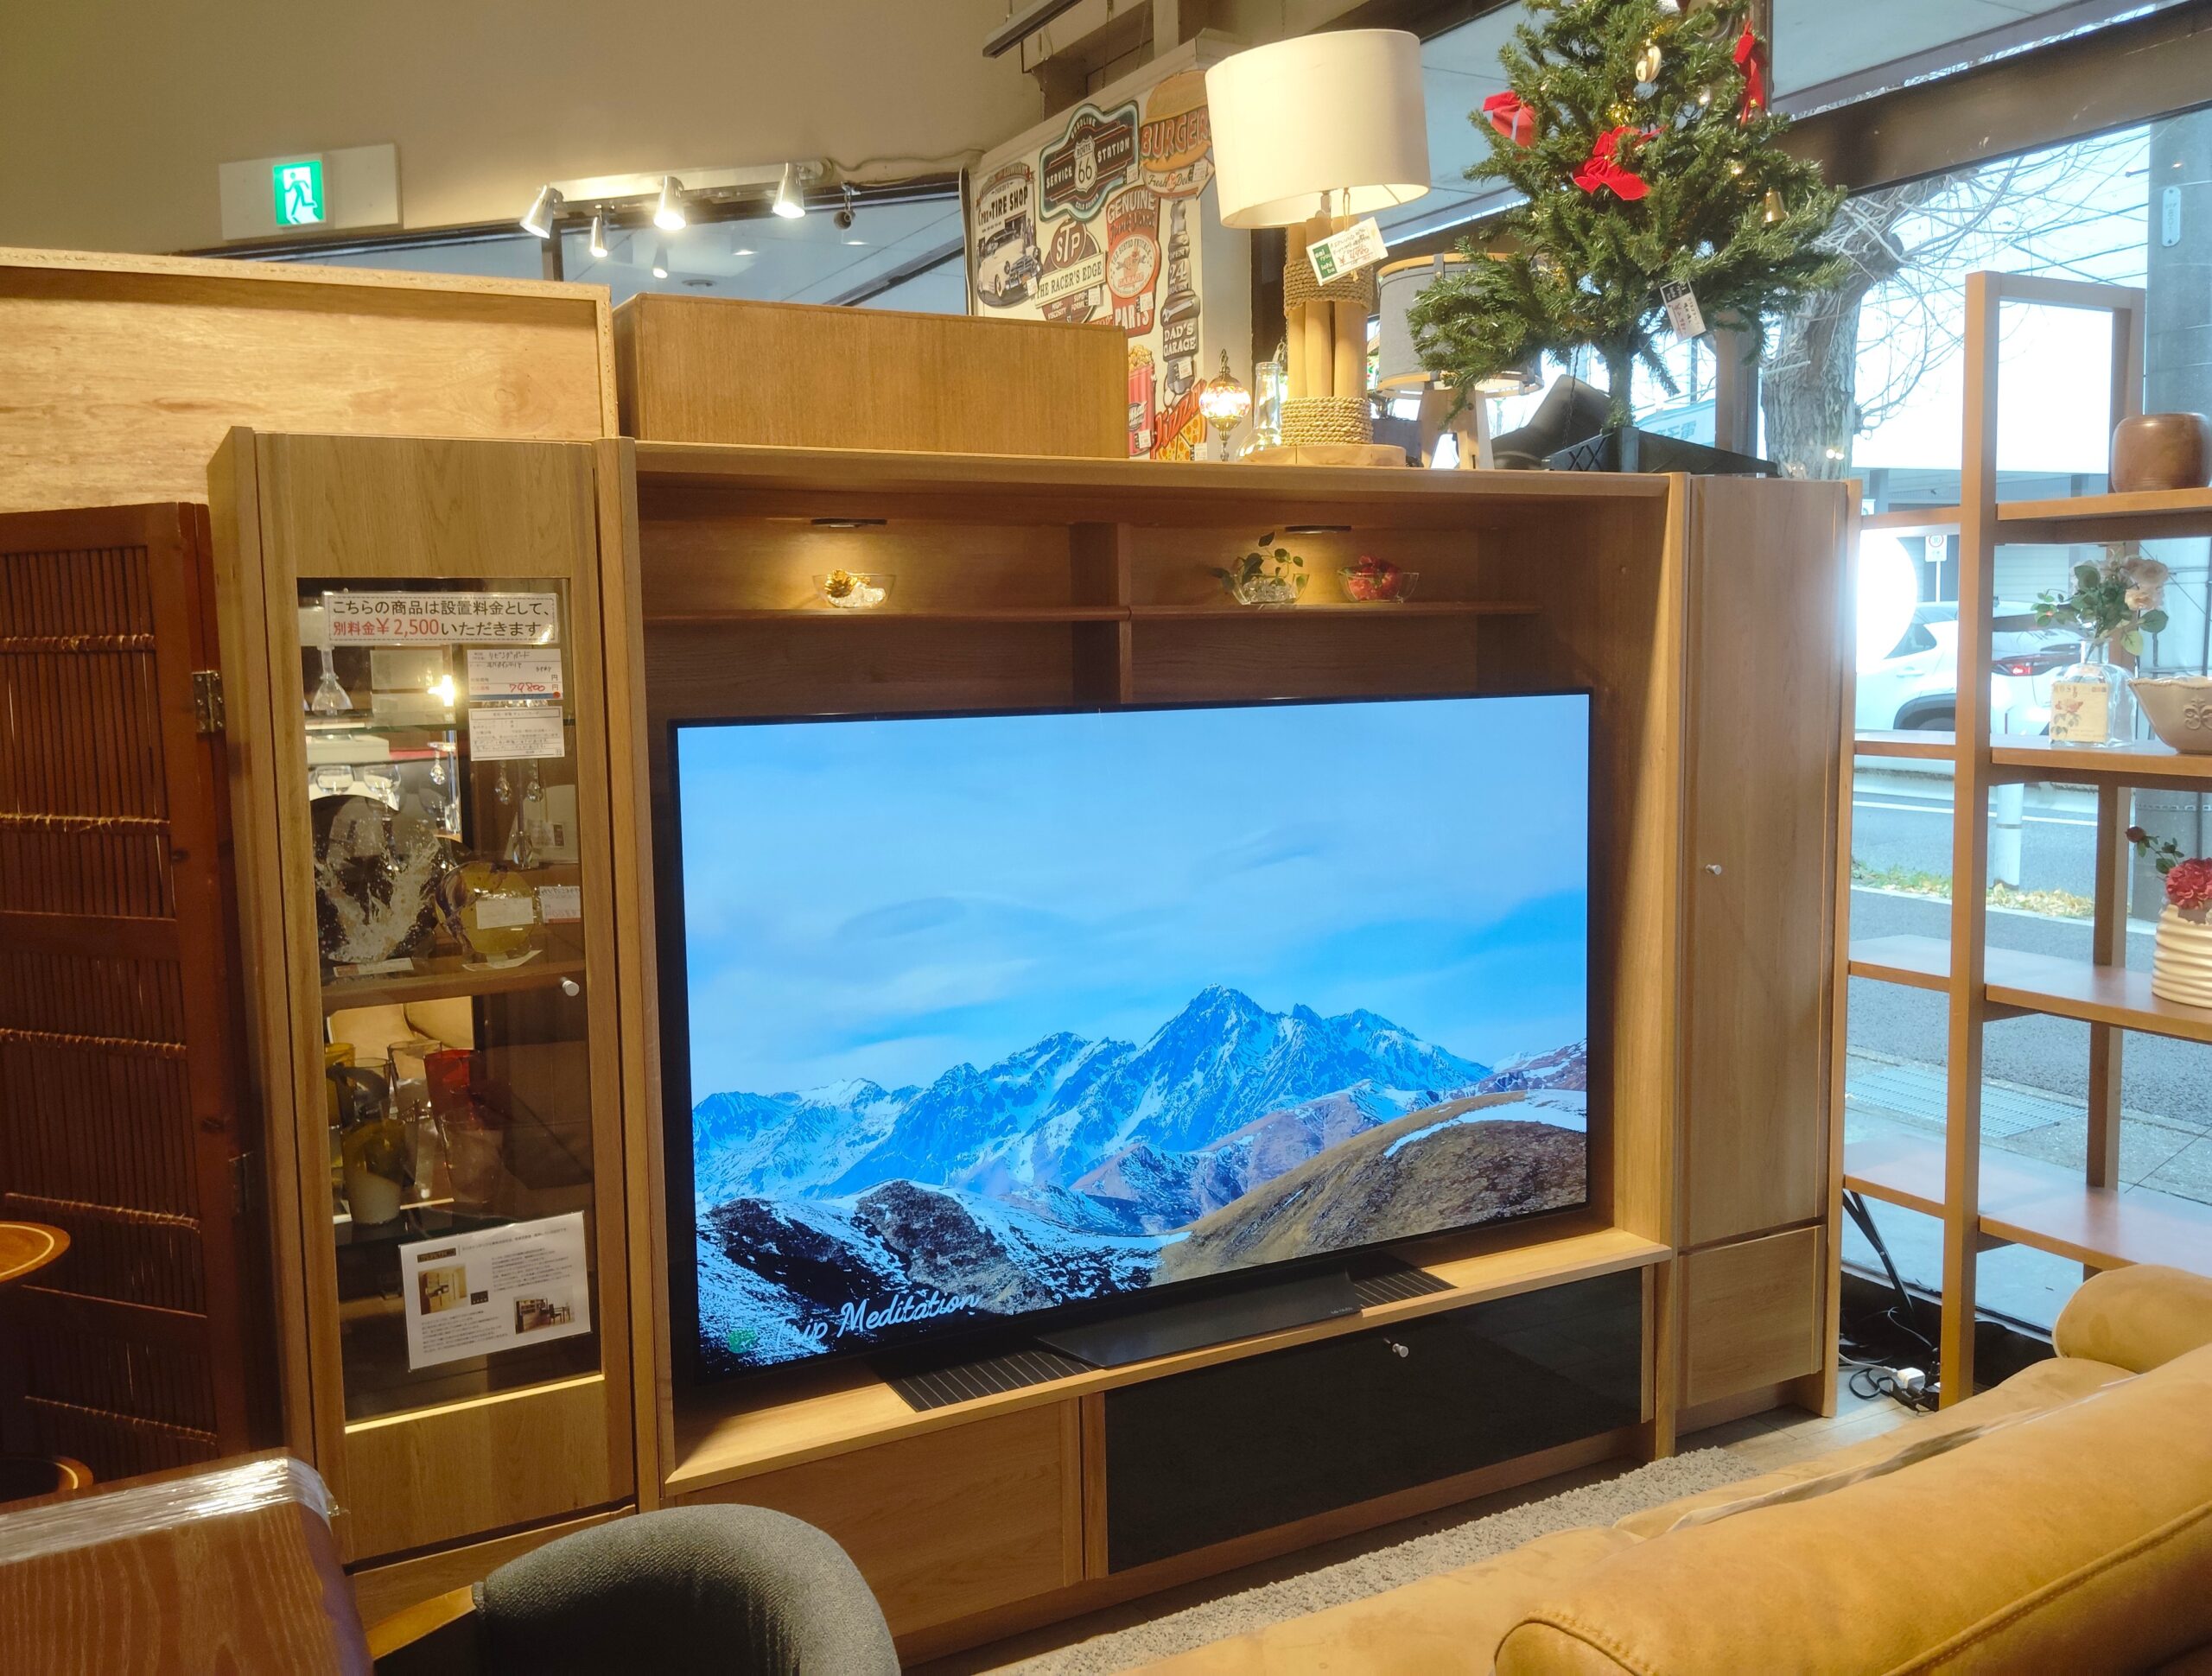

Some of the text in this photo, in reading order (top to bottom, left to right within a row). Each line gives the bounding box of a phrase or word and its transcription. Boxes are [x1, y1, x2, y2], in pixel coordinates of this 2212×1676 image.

[1141, 106, 1210, 158] BURGER
[1046, 166, 1072, 188] SERVICE
[1078, 157, 1092, 183] 66
[1097, 136, 1129, 163] STATION
[1077, 143, 1091, 156] ROUTE
[1147, 175, 1166, 188] Fresh
[991, 195, 1007, 219] TIRE
[1010, 186, 1027, 211] SHOP
[1107, 188, 1155, 224] GENUINE
[1056, 221, 1080, 263] STP
[1037, 261, 1102, 299] THE RACER'S EDGE
[1169, 261, 1187, 284] 24
[1164, 322, 1194, 342] DAD'S
[1163, 338, 1197, 357] GARAGE
[333, 600, 550, 616] こちらの商品は設置料金として、
[333, 617, 542, 638] 別料金¥2,500いただきます
[836, 1289, 982, 1338] Meditation
